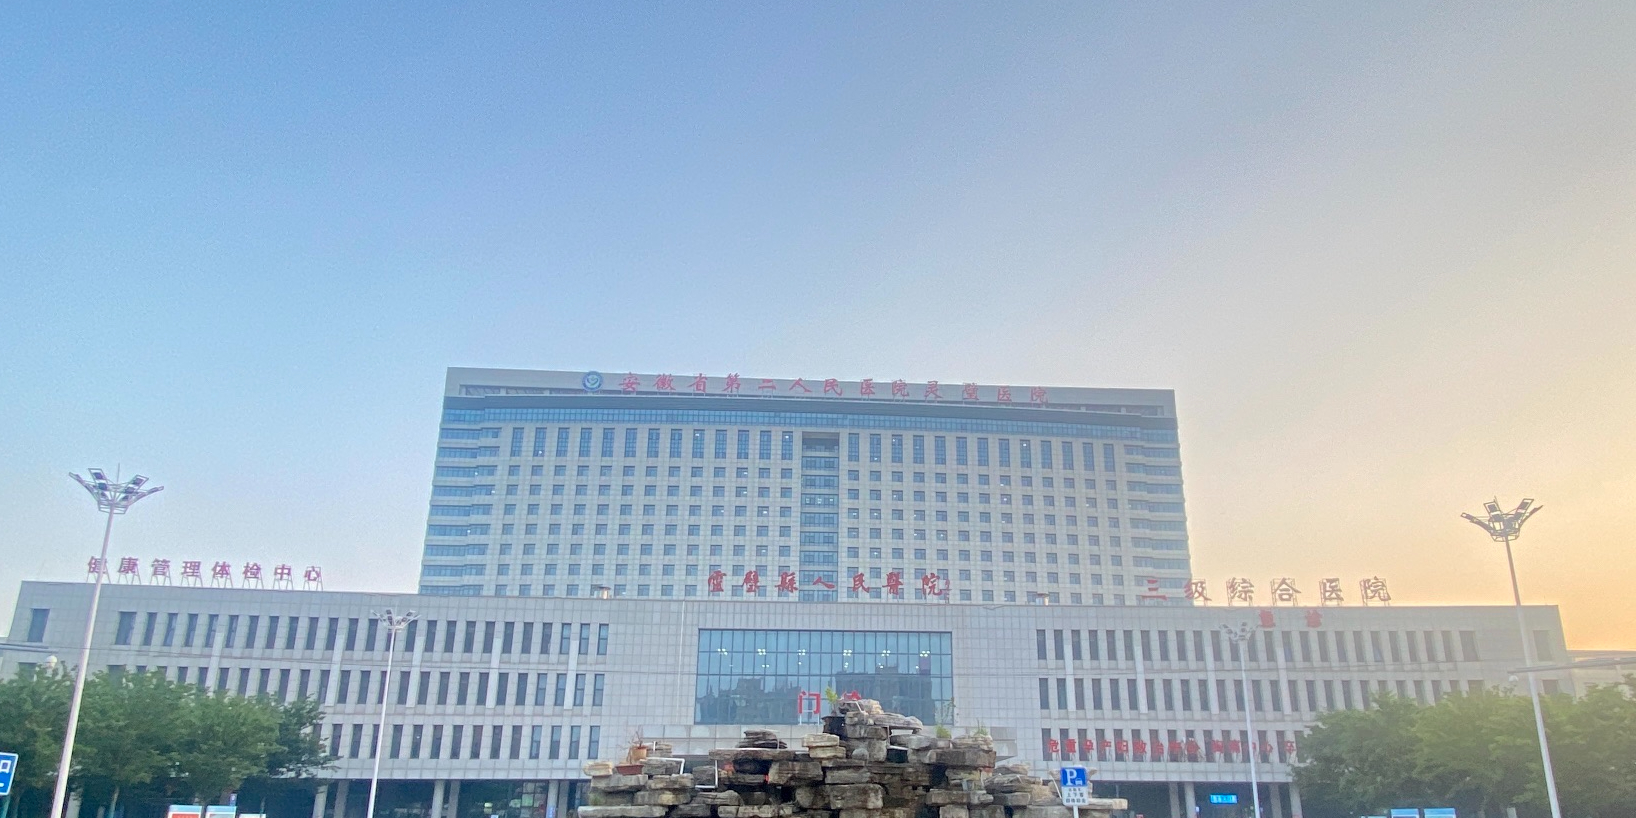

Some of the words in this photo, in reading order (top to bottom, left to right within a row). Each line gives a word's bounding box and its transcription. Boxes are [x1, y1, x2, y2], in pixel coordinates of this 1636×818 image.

[88, 556, 320, 581] 健康管理体检中心
[1141, 576, 1391, 601] 三级综合医院
[1065, 769, 1077, 785] P
